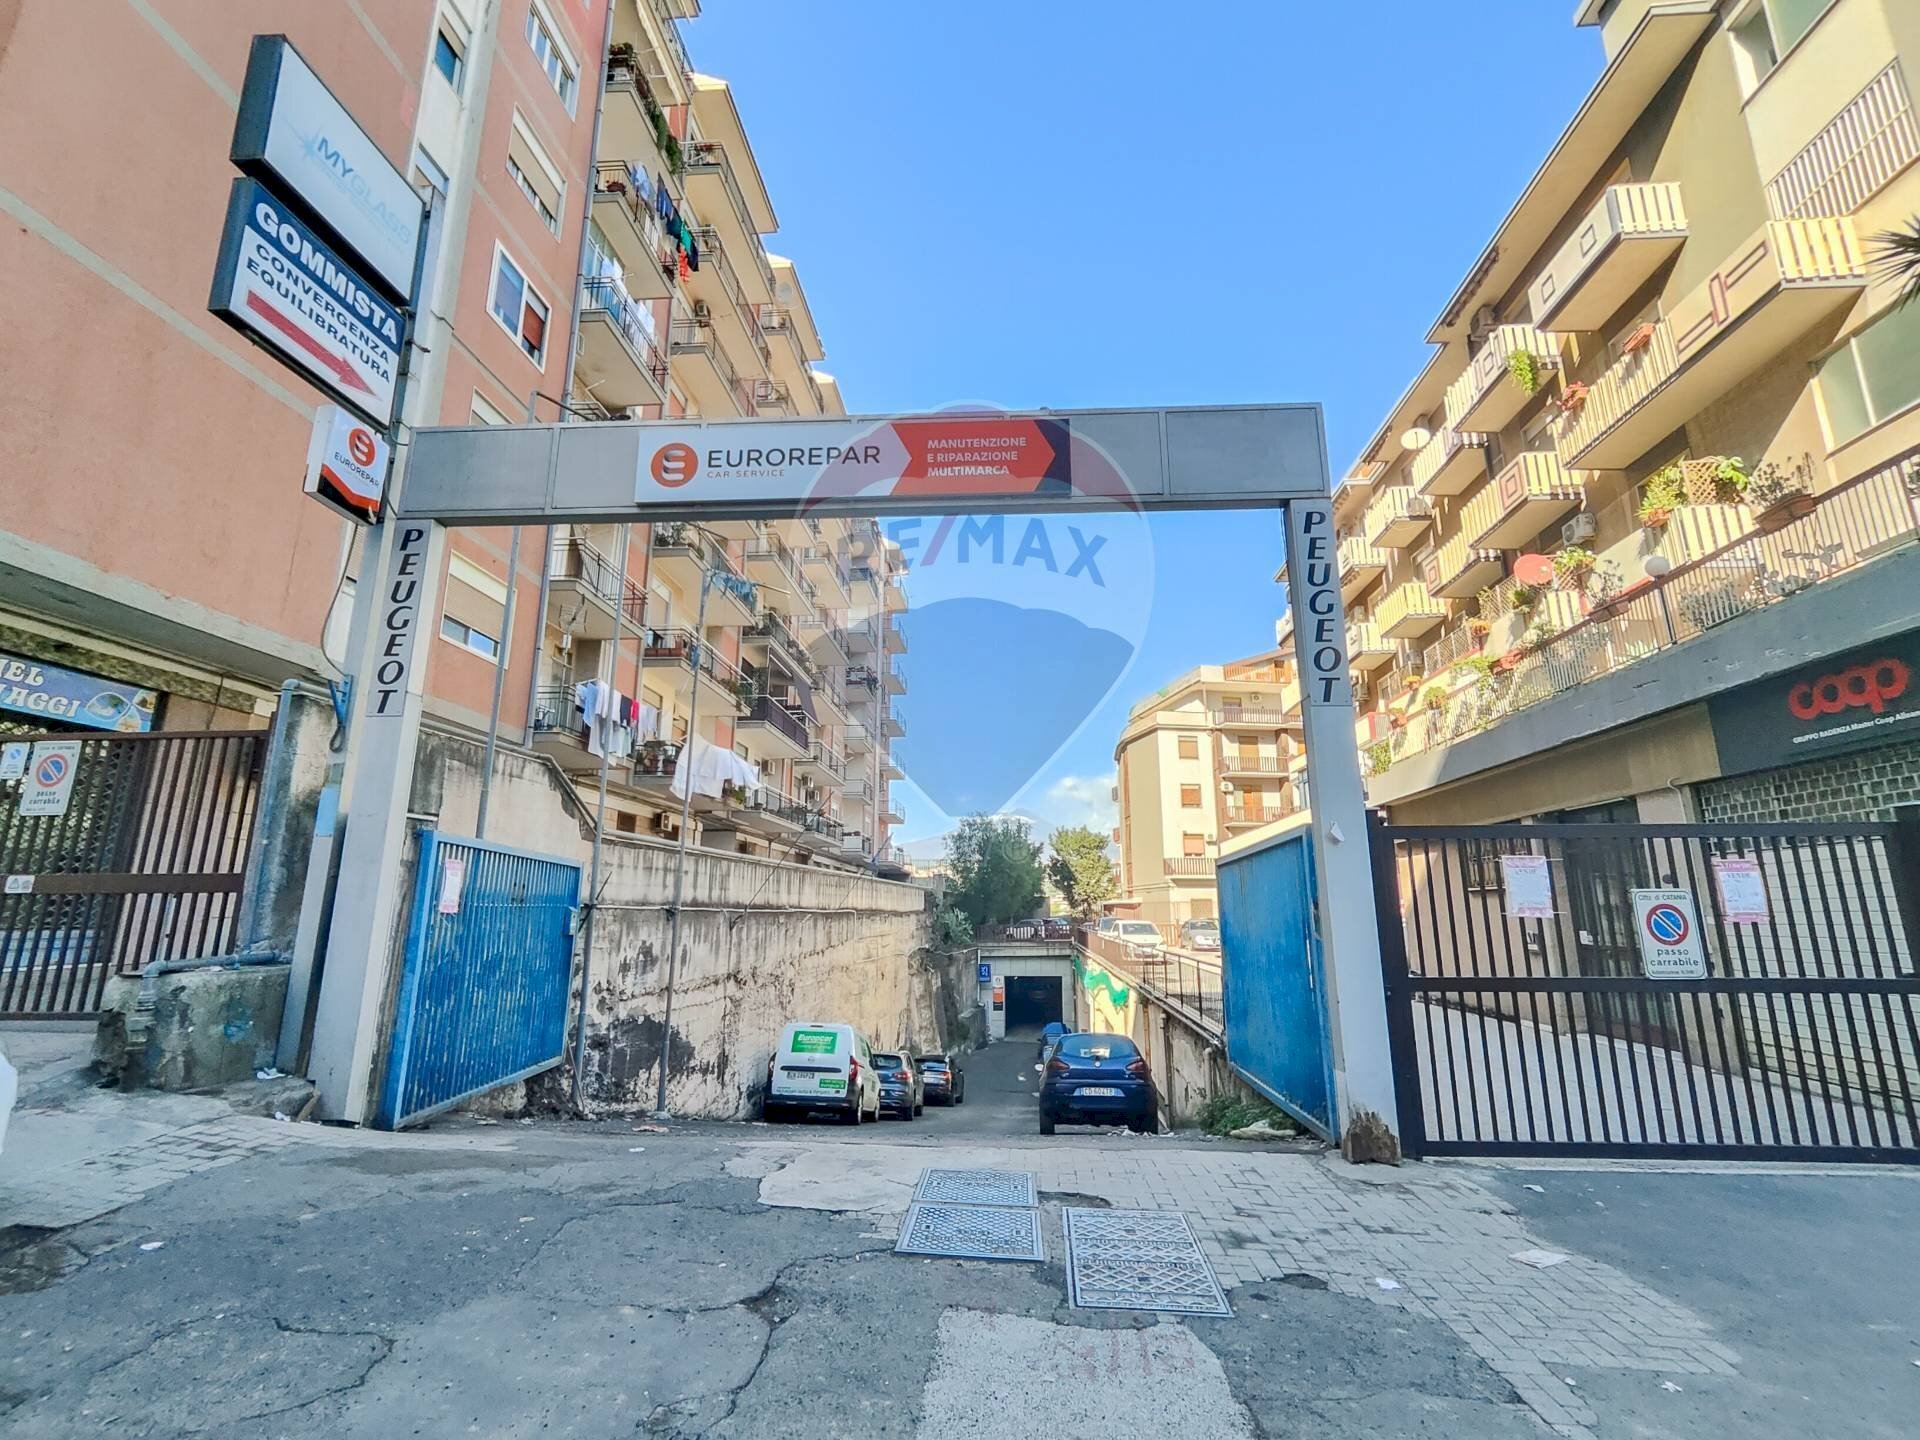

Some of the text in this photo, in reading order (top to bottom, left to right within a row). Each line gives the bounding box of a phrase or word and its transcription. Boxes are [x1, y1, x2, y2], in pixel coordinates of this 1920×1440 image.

[255, 202, 398, 345] GOMMISTA
[256, 243, 389, 364] CONVERGENZA
[246, 257, 390, 383] EQUILIBRATURA
[707, 445, 880, 468] EUROREPAR
[927, 436, 1027, 449] MANUTENZIONE
[927, 450, 1018, 462] E RIPARAZIONE
[707, 468, 785, 479] CAR SERVICE
[927, 465, 1010, 478] MULTIMARCA
[376, 528, 424, 714] PEUGEOT
[1303, 511, 1342, 703] PEUGEOT
[0, 658, 44, 686] EL
[0, 684, 81, 717] AGGI
[1788, 658, 1910, 720] coop
[1650, 957, 1700, 967] carrabile
[1657, 948, 1689, 957] passo
